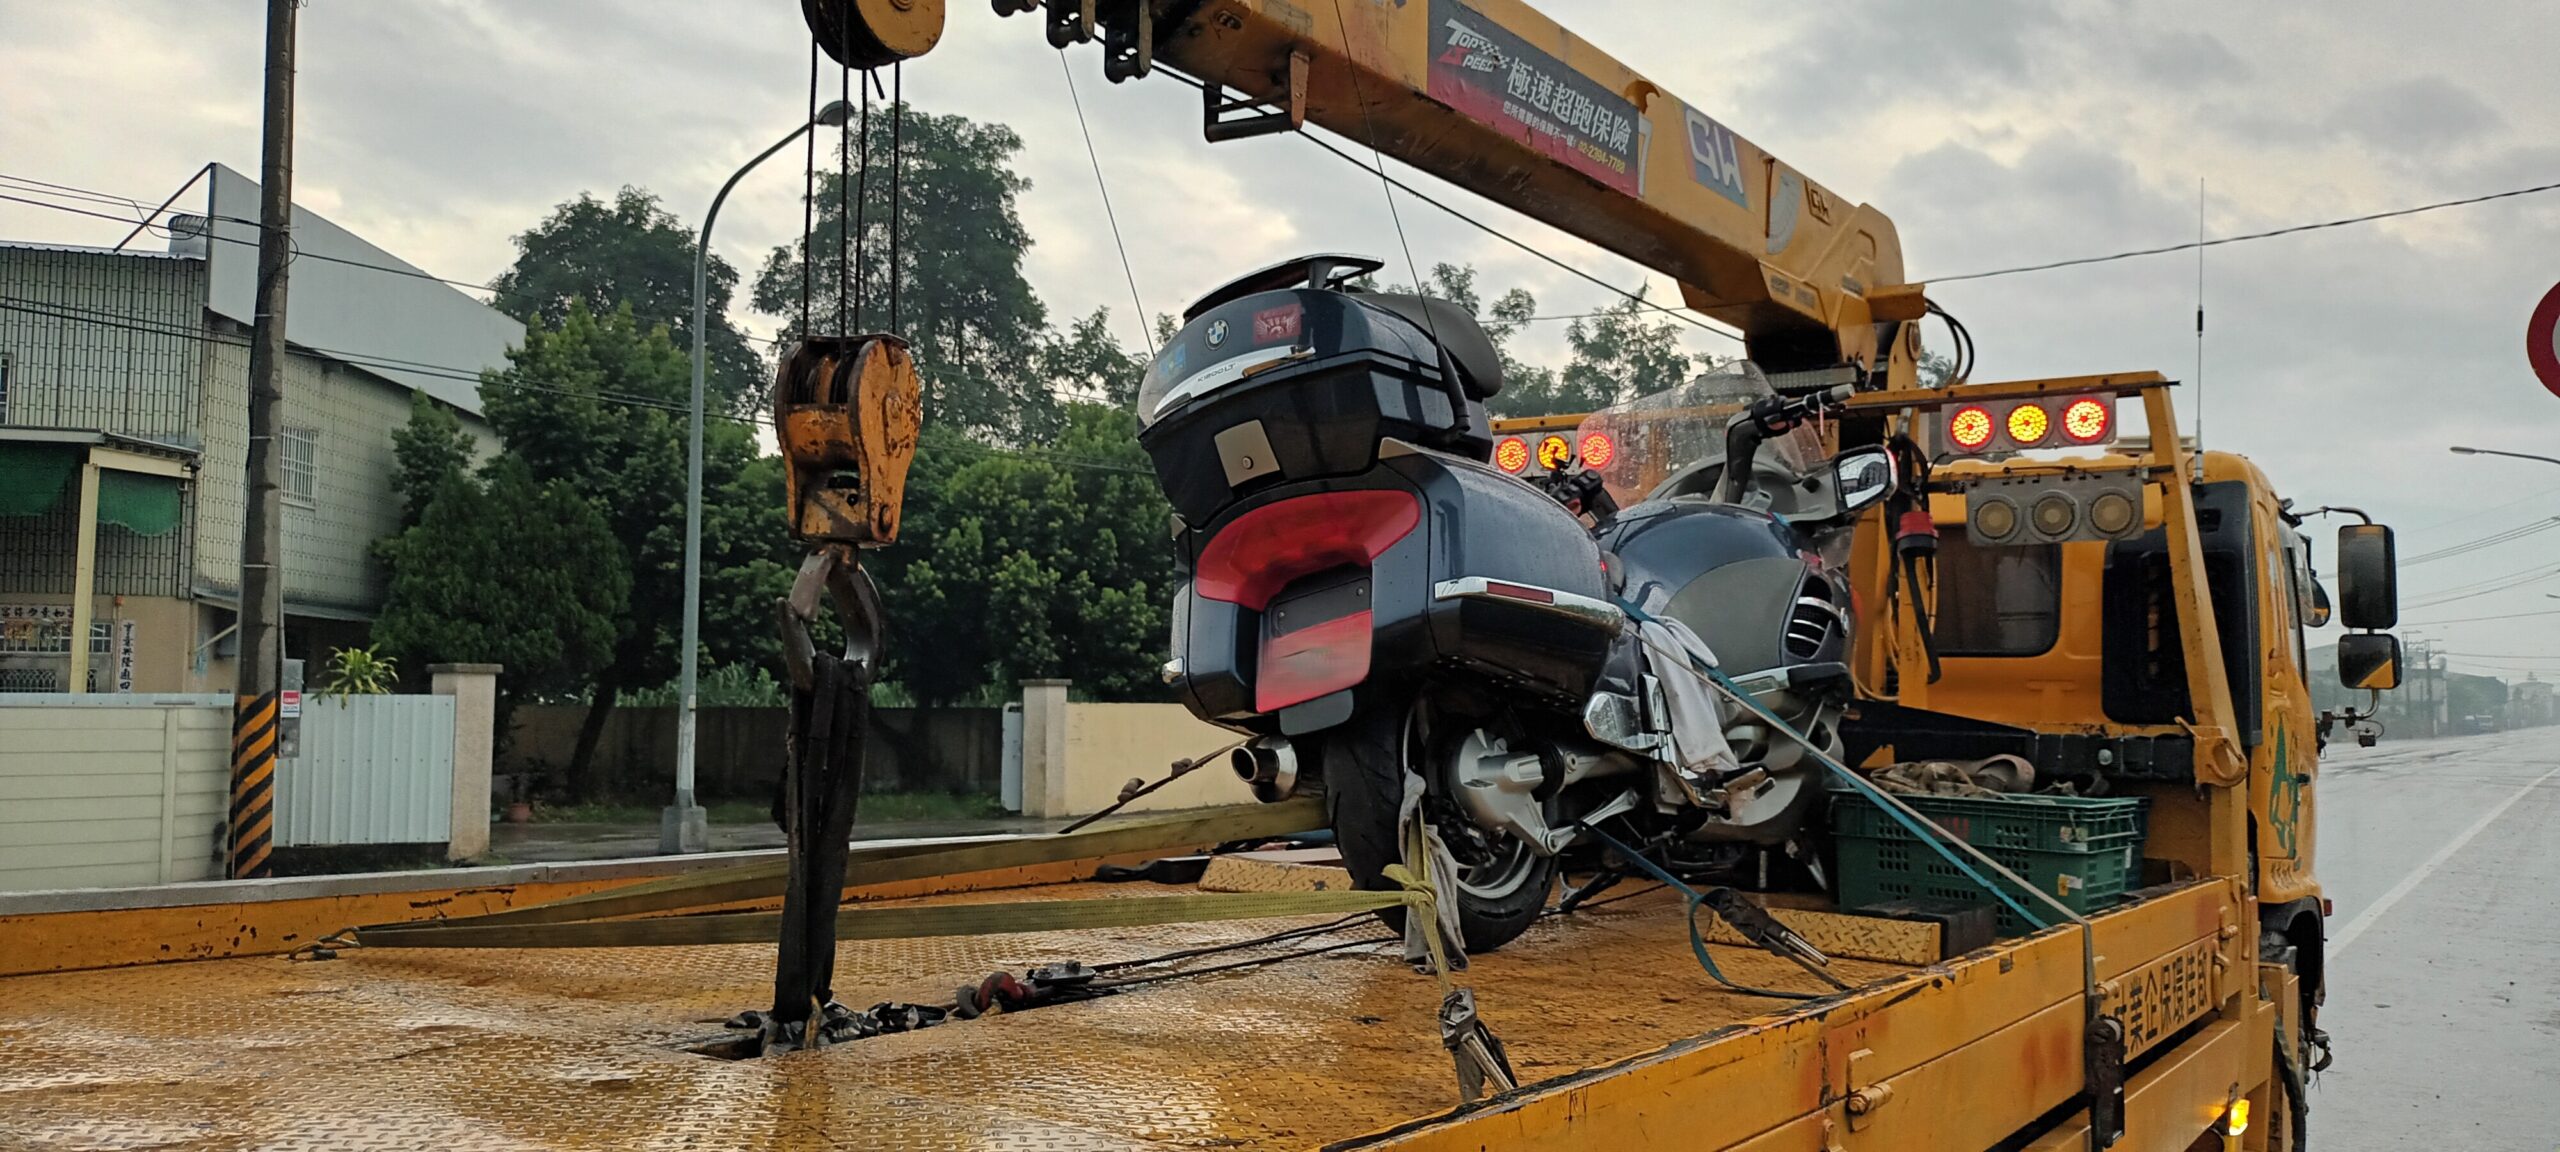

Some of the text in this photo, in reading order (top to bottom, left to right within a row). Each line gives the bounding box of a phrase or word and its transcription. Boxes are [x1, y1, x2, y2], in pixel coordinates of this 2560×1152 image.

[1507, 56, 1632, 156] 極速超跑保險
